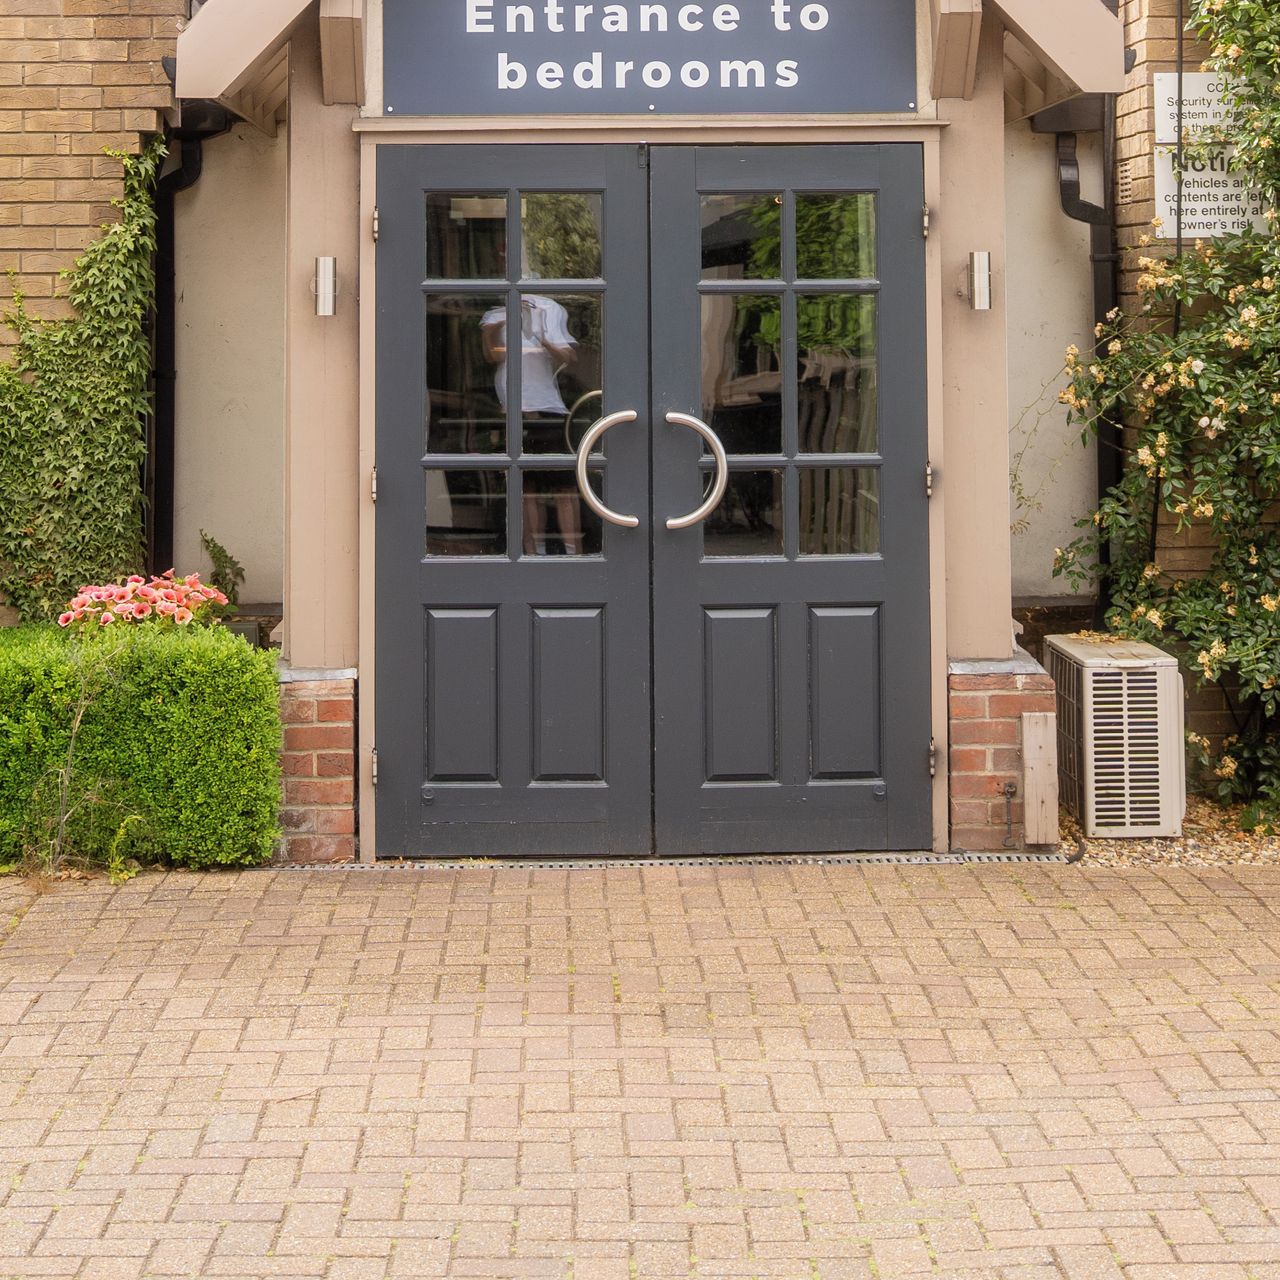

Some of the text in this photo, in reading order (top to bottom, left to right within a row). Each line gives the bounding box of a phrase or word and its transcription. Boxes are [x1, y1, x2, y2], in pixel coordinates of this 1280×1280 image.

[496, 52, 800, 89] bedrooms
[1167, 96, 1212, 108] Security
[1212, 109, 1222, 119] in
[1164, 190, 1265, 202] contents are lef
[1169, 205, 1264, 217] here entirely at
[1180, 219, 1227, 230] owner's
